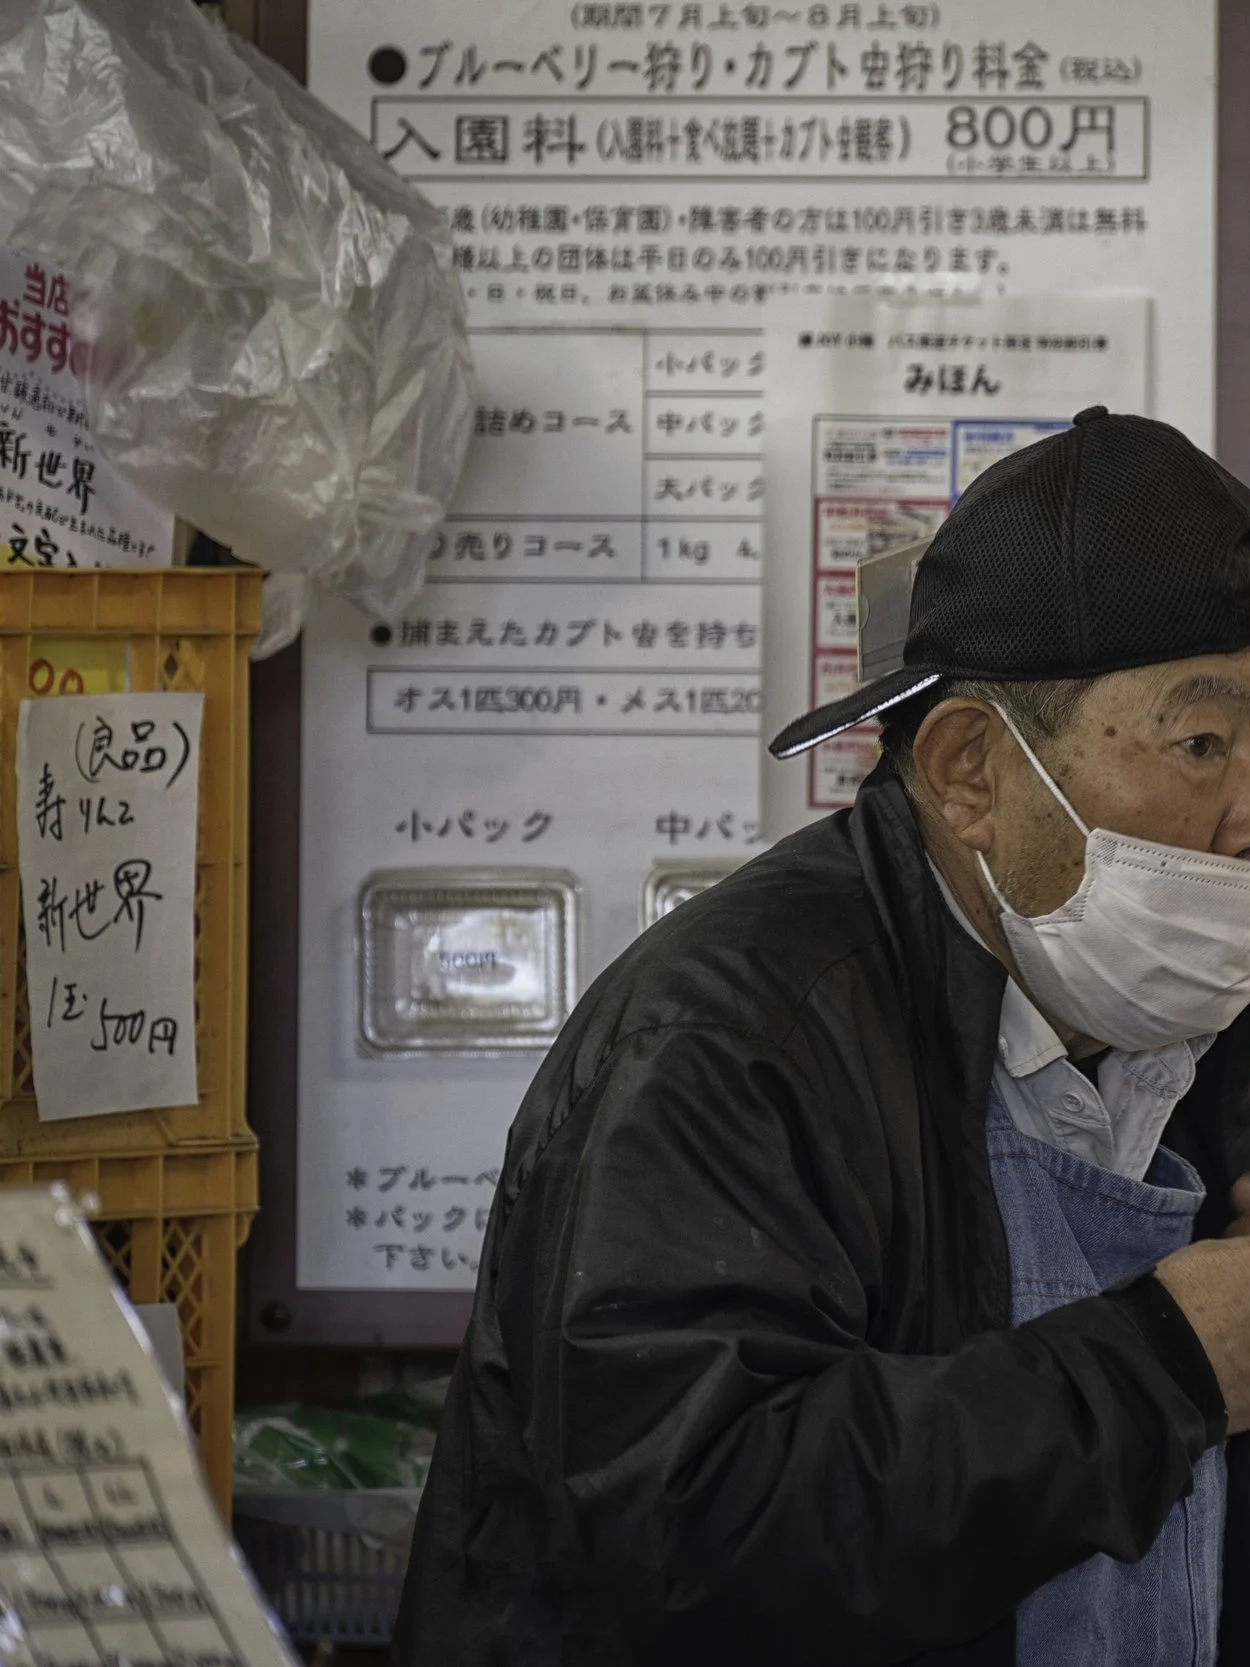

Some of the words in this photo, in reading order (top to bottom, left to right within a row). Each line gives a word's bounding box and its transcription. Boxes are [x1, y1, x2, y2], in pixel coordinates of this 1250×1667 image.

[383, 112, 586, 166] 入園料
[945, 104, 1117, 152] 800円
[23, 262, 69, 317] 当店
[904, 363, 1002, 398] みほん
[0, 421, 96, 516] 新世界
[75, 716, 190, 789] (良品)
[396, 810, 553, 842] 小パック
[37, 858, 163, 952] 新世界
[91, 997, 178, 1056] 500円
